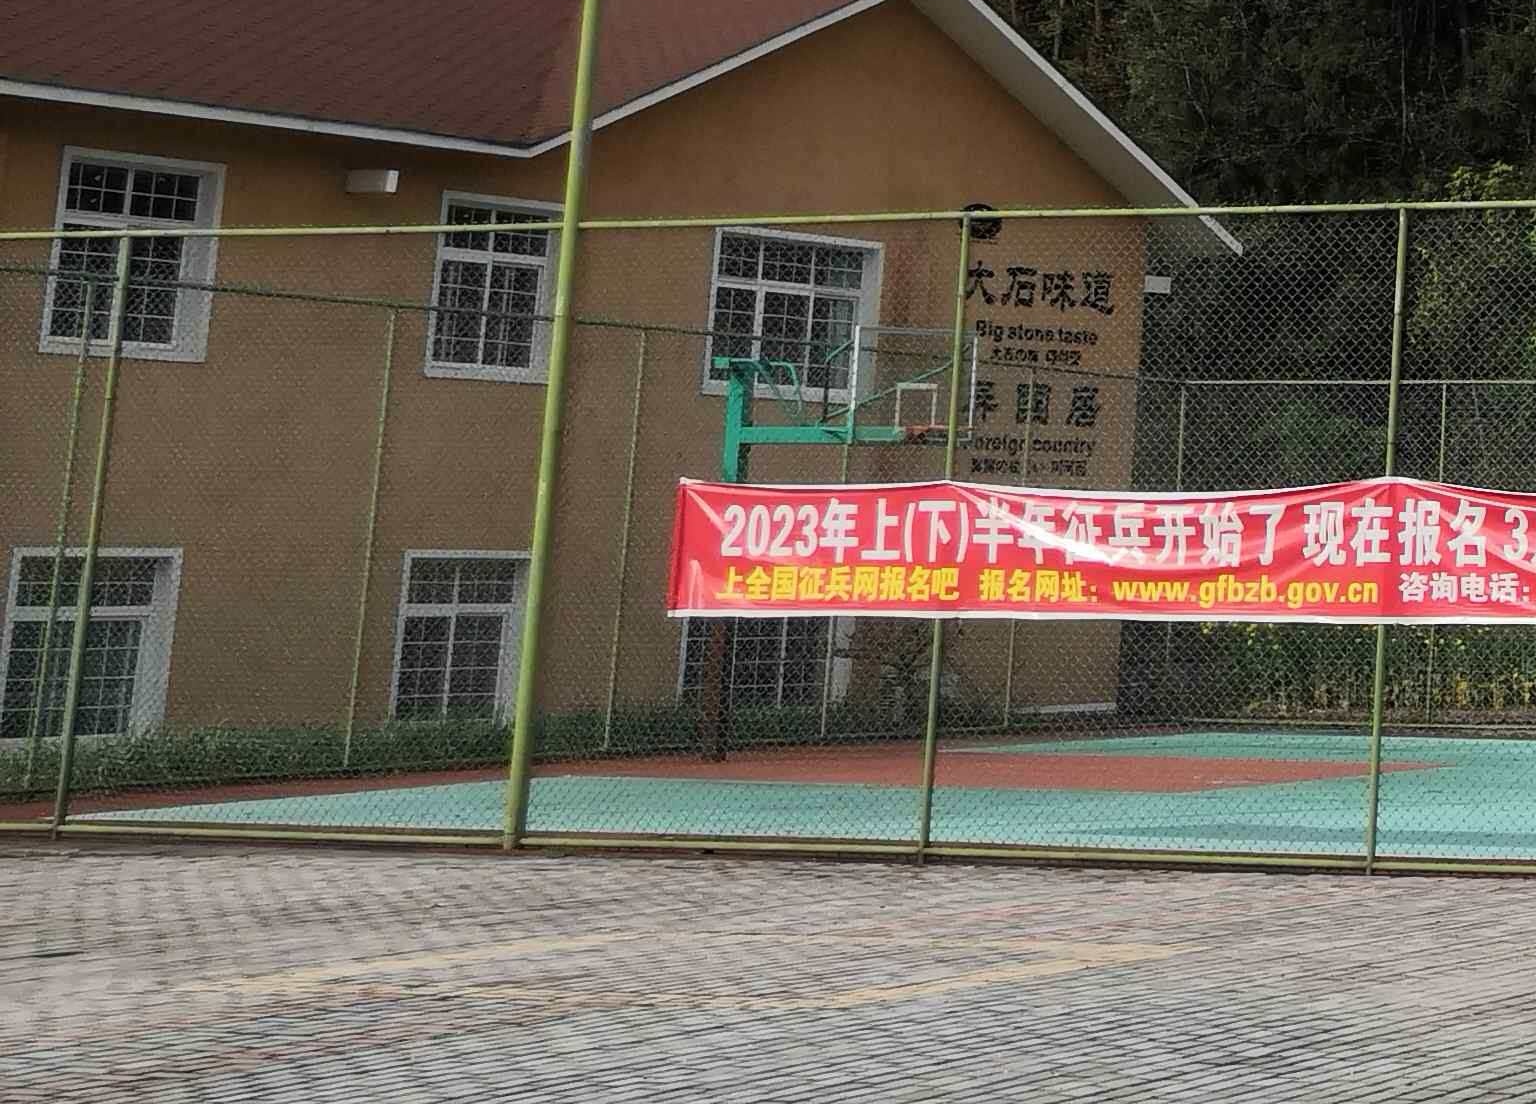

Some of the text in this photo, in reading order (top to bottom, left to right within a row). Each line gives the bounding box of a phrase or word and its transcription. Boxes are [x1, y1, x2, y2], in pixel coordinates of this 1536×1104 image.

[966, 260, 1114, 315] 大石味道
[976, 320, 1098, 345] Big stone taste
[963, 434, 1096, 457] oreign country
[716, 565, 960, 602] 上全国征兵网报名吧
